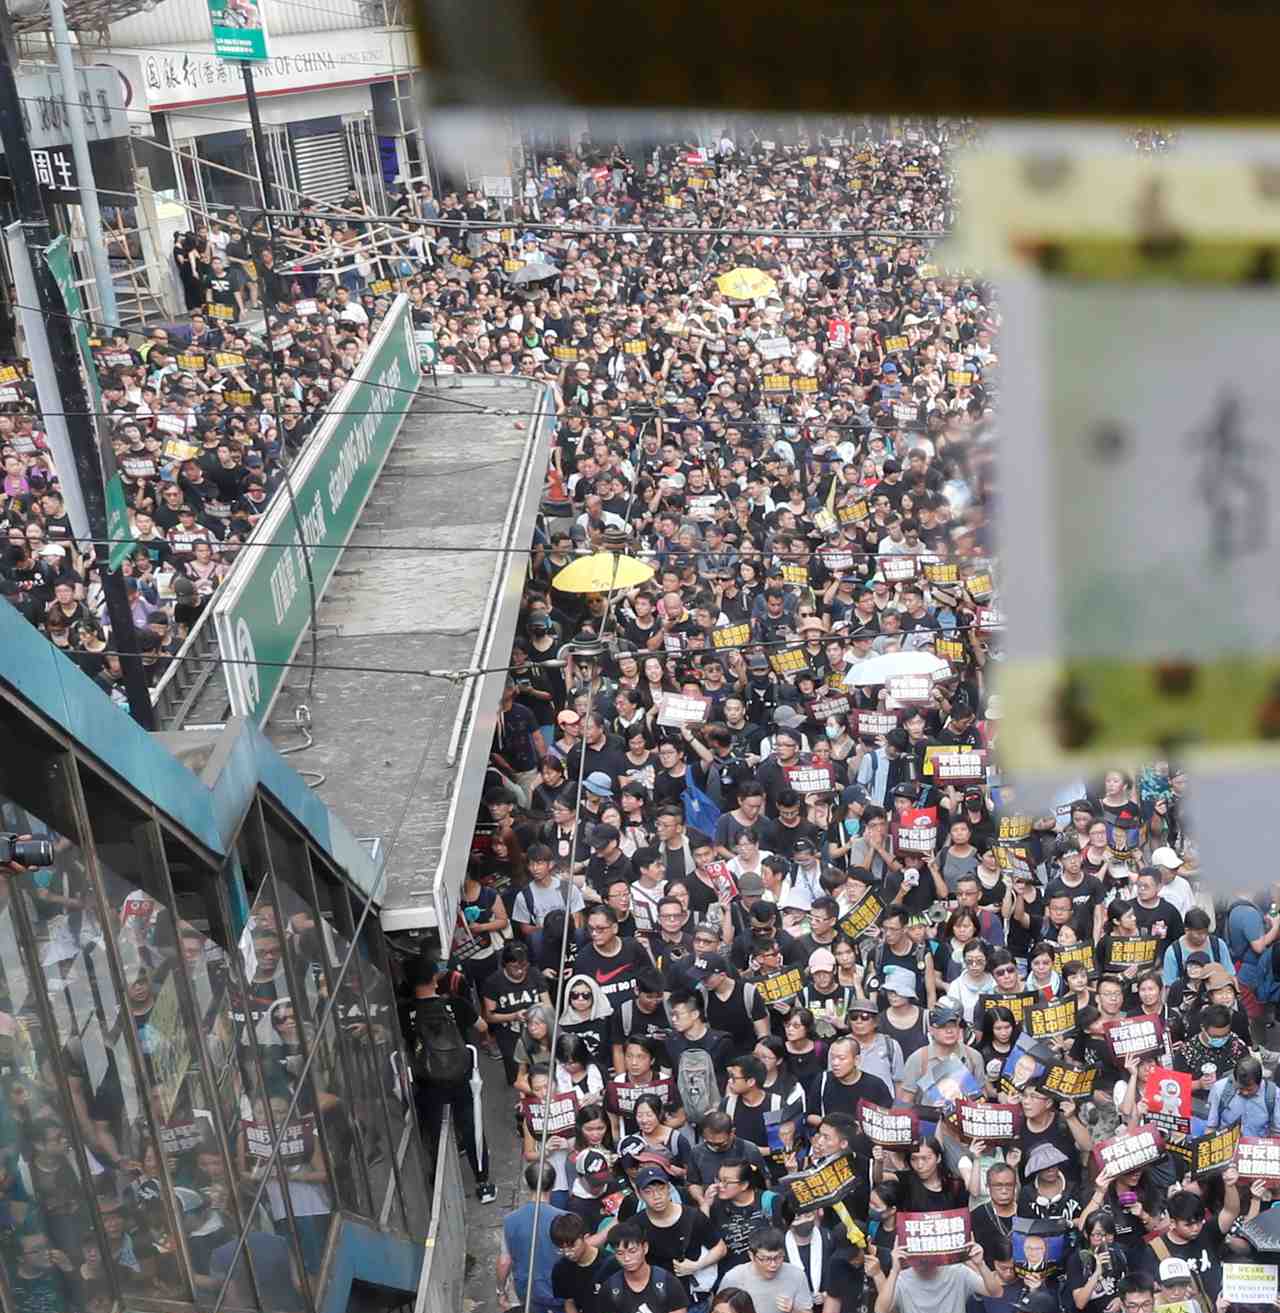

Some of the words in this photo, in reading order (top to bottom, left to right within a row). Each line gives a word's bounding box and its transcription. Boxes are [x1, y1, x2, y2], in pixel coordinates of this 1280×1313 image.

[295, 51, 337, 74] CHINA
[905, 1217, 965, 1236] 平反暴動
